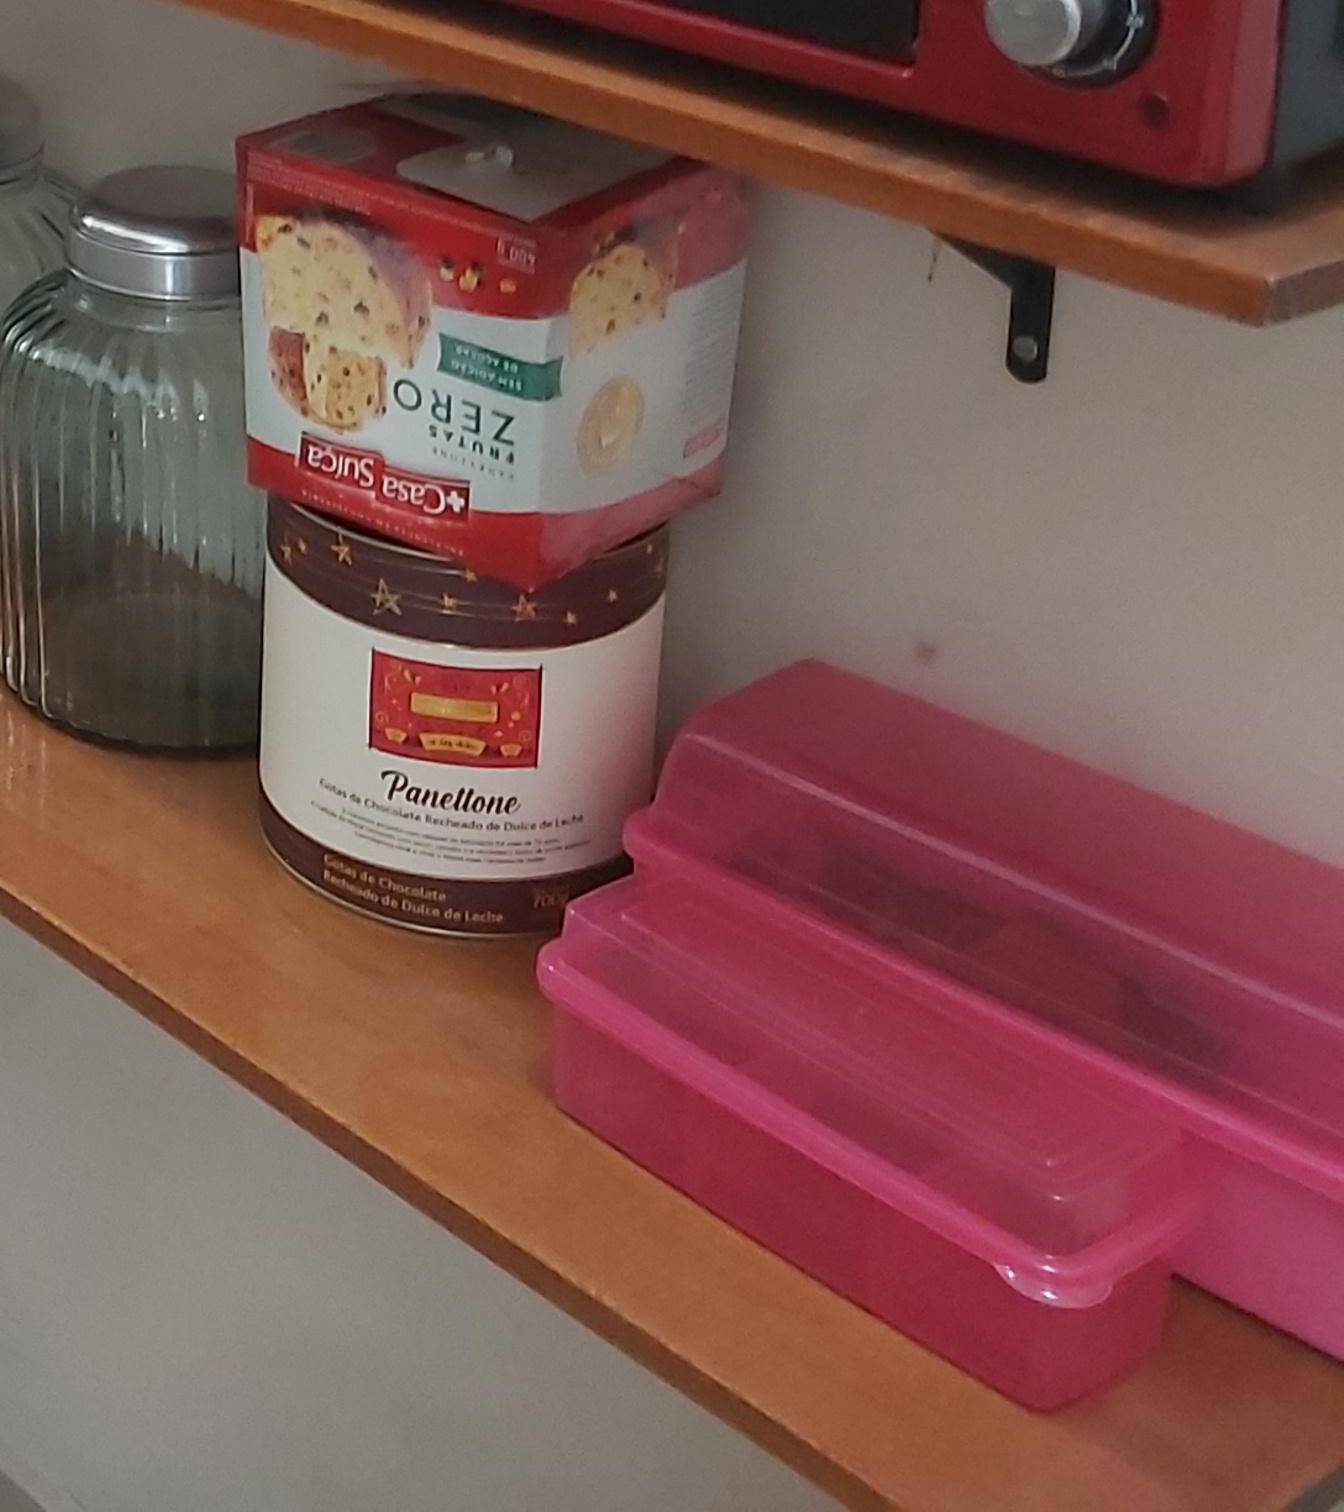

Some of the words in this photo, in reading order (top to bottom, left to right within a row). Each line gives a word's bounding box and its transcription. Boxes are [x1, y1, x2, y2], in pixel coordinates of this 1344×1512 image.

[393, 379, 515, 446] ZERO
[427, 425, 515, 464] FRUTAS
[306, 443, 375, 488] Suíça
[382, 473, 447, 515] Casa
[485, 819, 501, 832] de
[359, 870, 376, 885] de
[378, 875, 447, 903] Chocolate
[380, 895, 399, 911] de
[400, 898, 441, 917] Dulce
[443, 907, 462, 922] de
[464, 909, 505, 924] Leche
